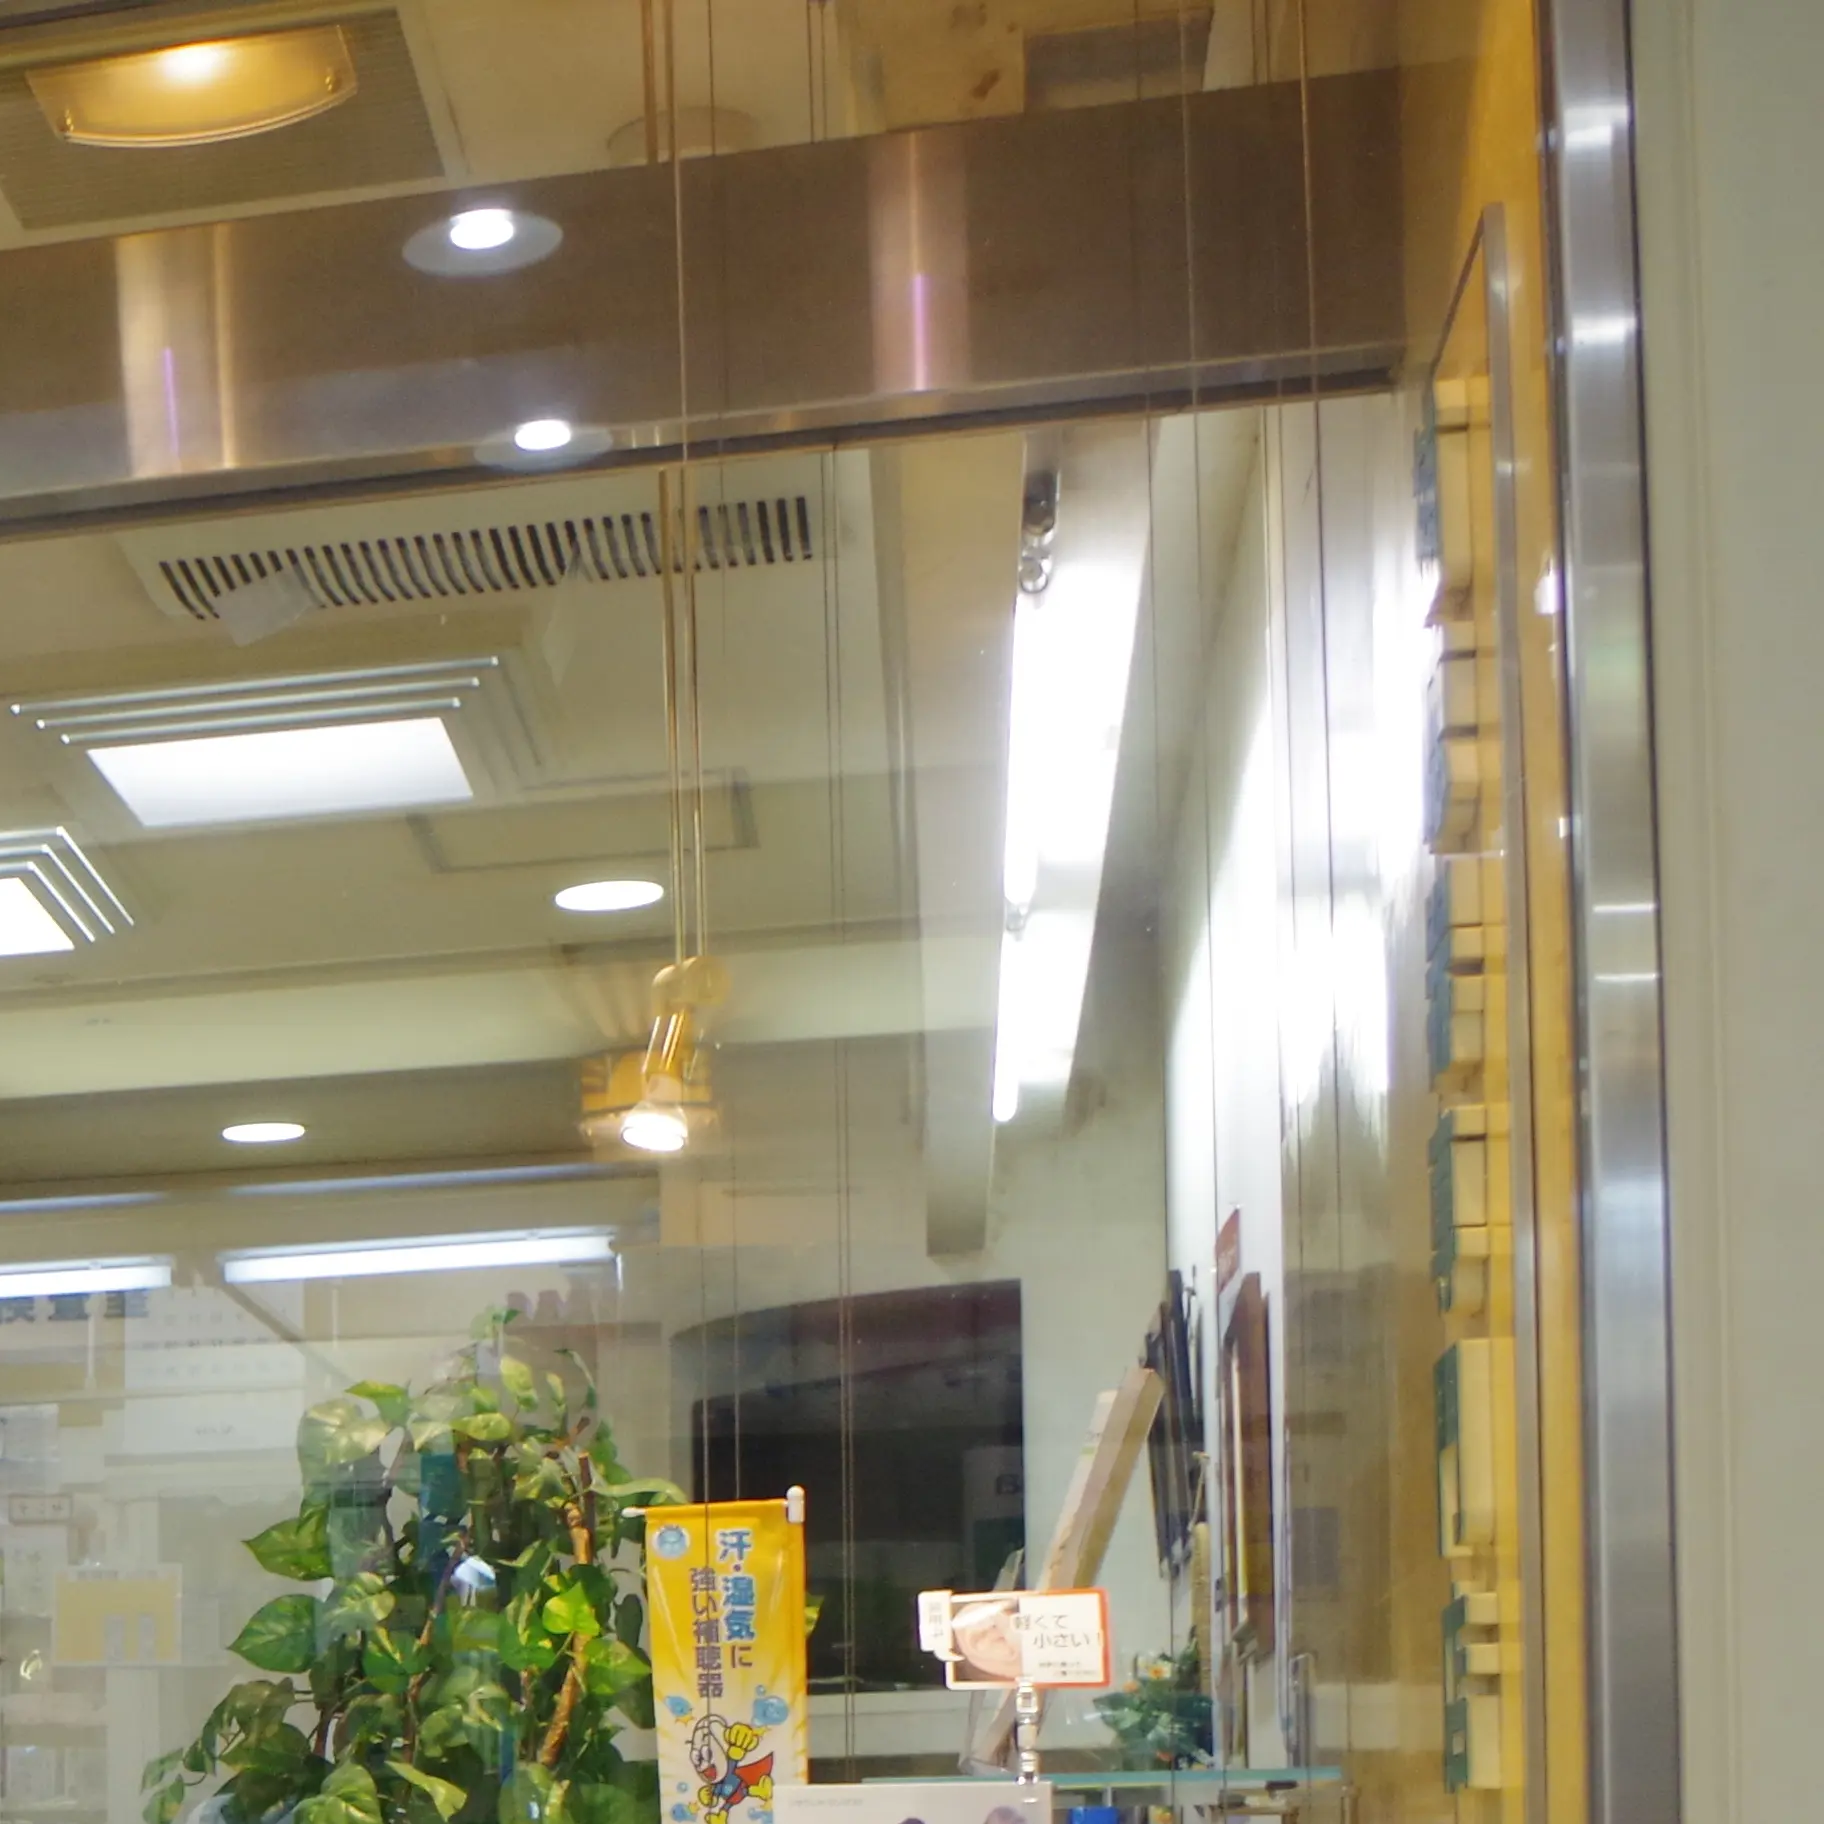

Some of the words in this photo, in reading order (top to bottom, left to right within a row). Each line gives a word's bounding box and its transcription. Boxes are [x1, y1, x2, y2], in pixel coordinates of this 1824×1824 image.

[689, 1566, 724, 1699] 強い補聴器
